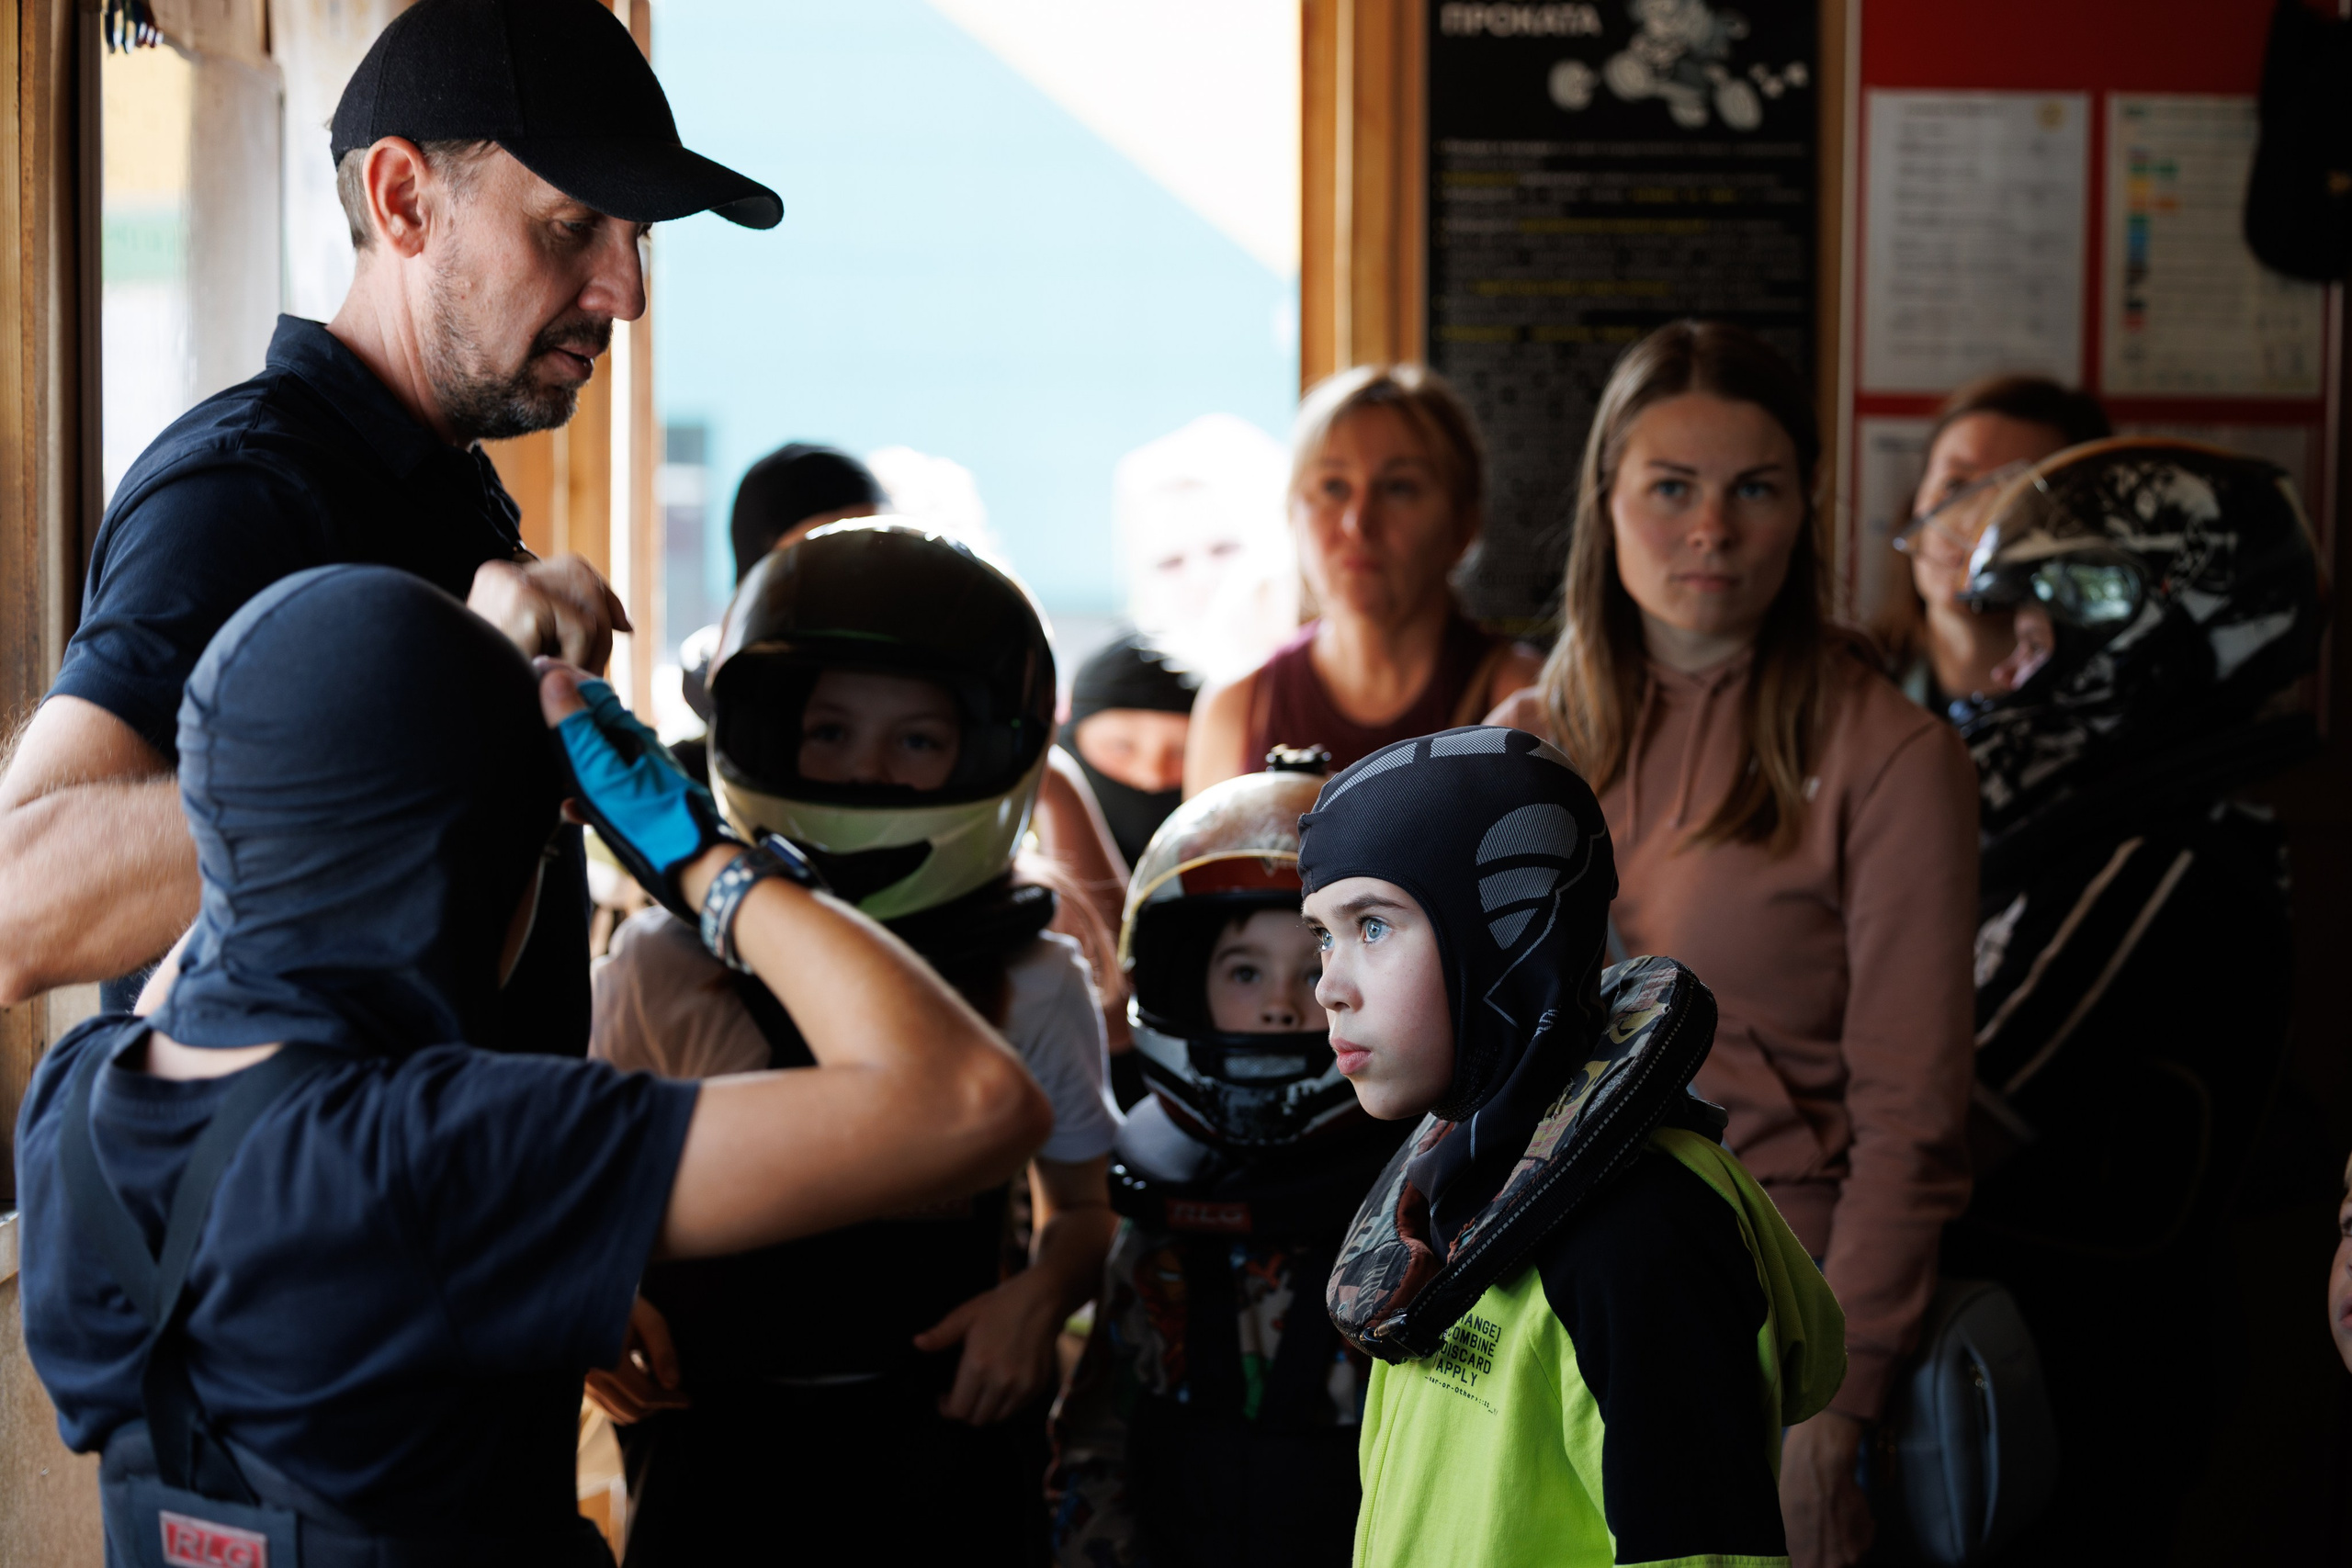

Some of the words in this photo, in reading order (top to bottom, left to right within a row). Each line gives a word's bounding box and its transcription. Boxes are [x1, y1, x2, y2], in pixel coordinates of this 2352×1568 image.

[1457, 1313, 1502, 1343] ANGE]
[1435, 1358, 1478, 1387] APPLY
[1441, 1341, 1492, 1375] DISCARD
[175, 1525, 254, 1568] RLG
